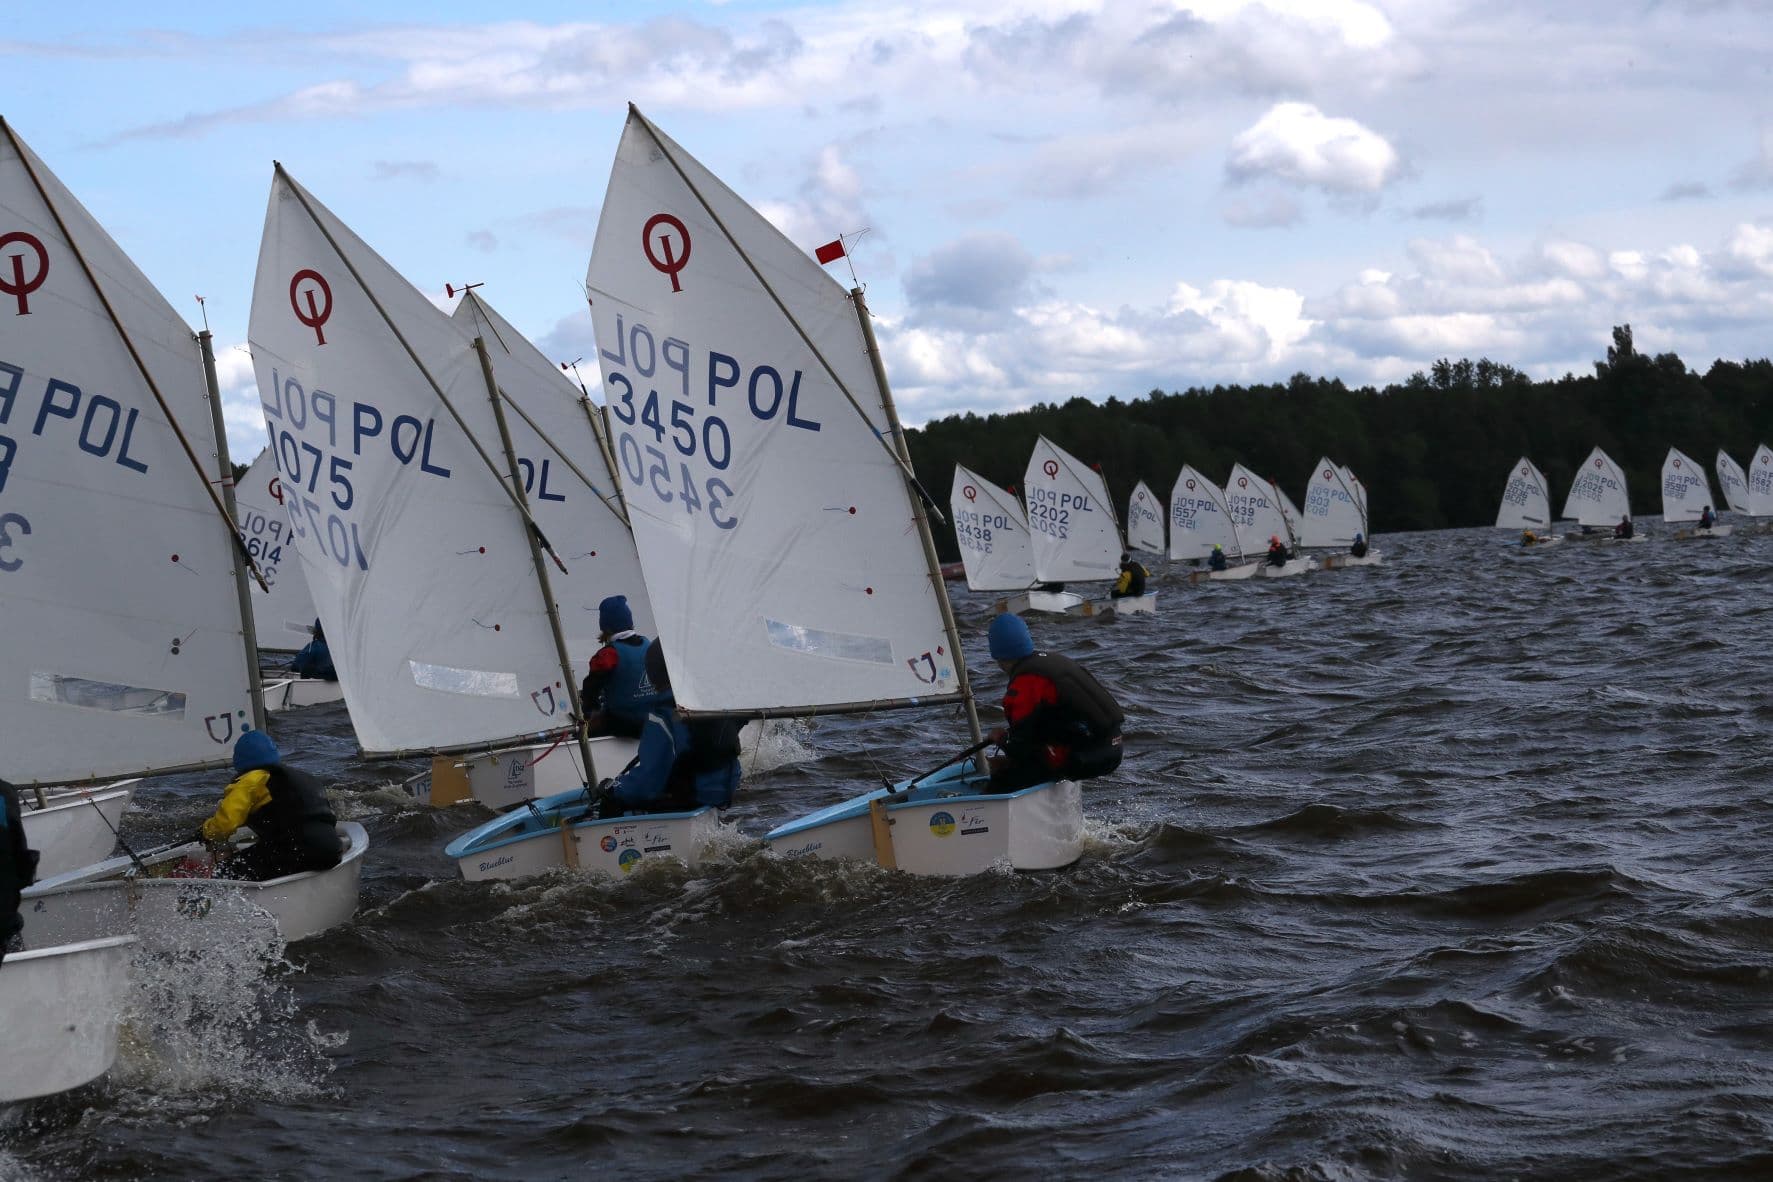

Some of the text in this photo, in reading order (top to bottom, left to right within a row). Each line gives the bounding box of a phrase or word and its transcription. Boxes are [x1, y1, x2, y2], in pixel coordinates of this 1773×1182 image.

[708, 350, 822, 432] POL
[33, 377, 149, 474] POL
[607, 371, 742, 470] 3450
[353, 401, 451, 479] POL
[268, 420, 354, 511] 1075
[518, 457, 566, 502] OL
[1601, 477, 1618, 490] POL
[1684, 476, 1701, 487] POL
[1330, 489, 1351, 503] POL
[1526, 484, 1540, 496] POL
[1061, 493, 1094, 512] POL
[1196, 499, 1218, 513] POL
[1249, 497, 1270, 509] POL
[1029, 501, 1069, 525] 2202
[1141, 509, 1157, 523] POL
[1172, 507, 1197, 519] 1557
[956, 521, 992, 542] 3438
[982, 514, 1014, 531] POL
